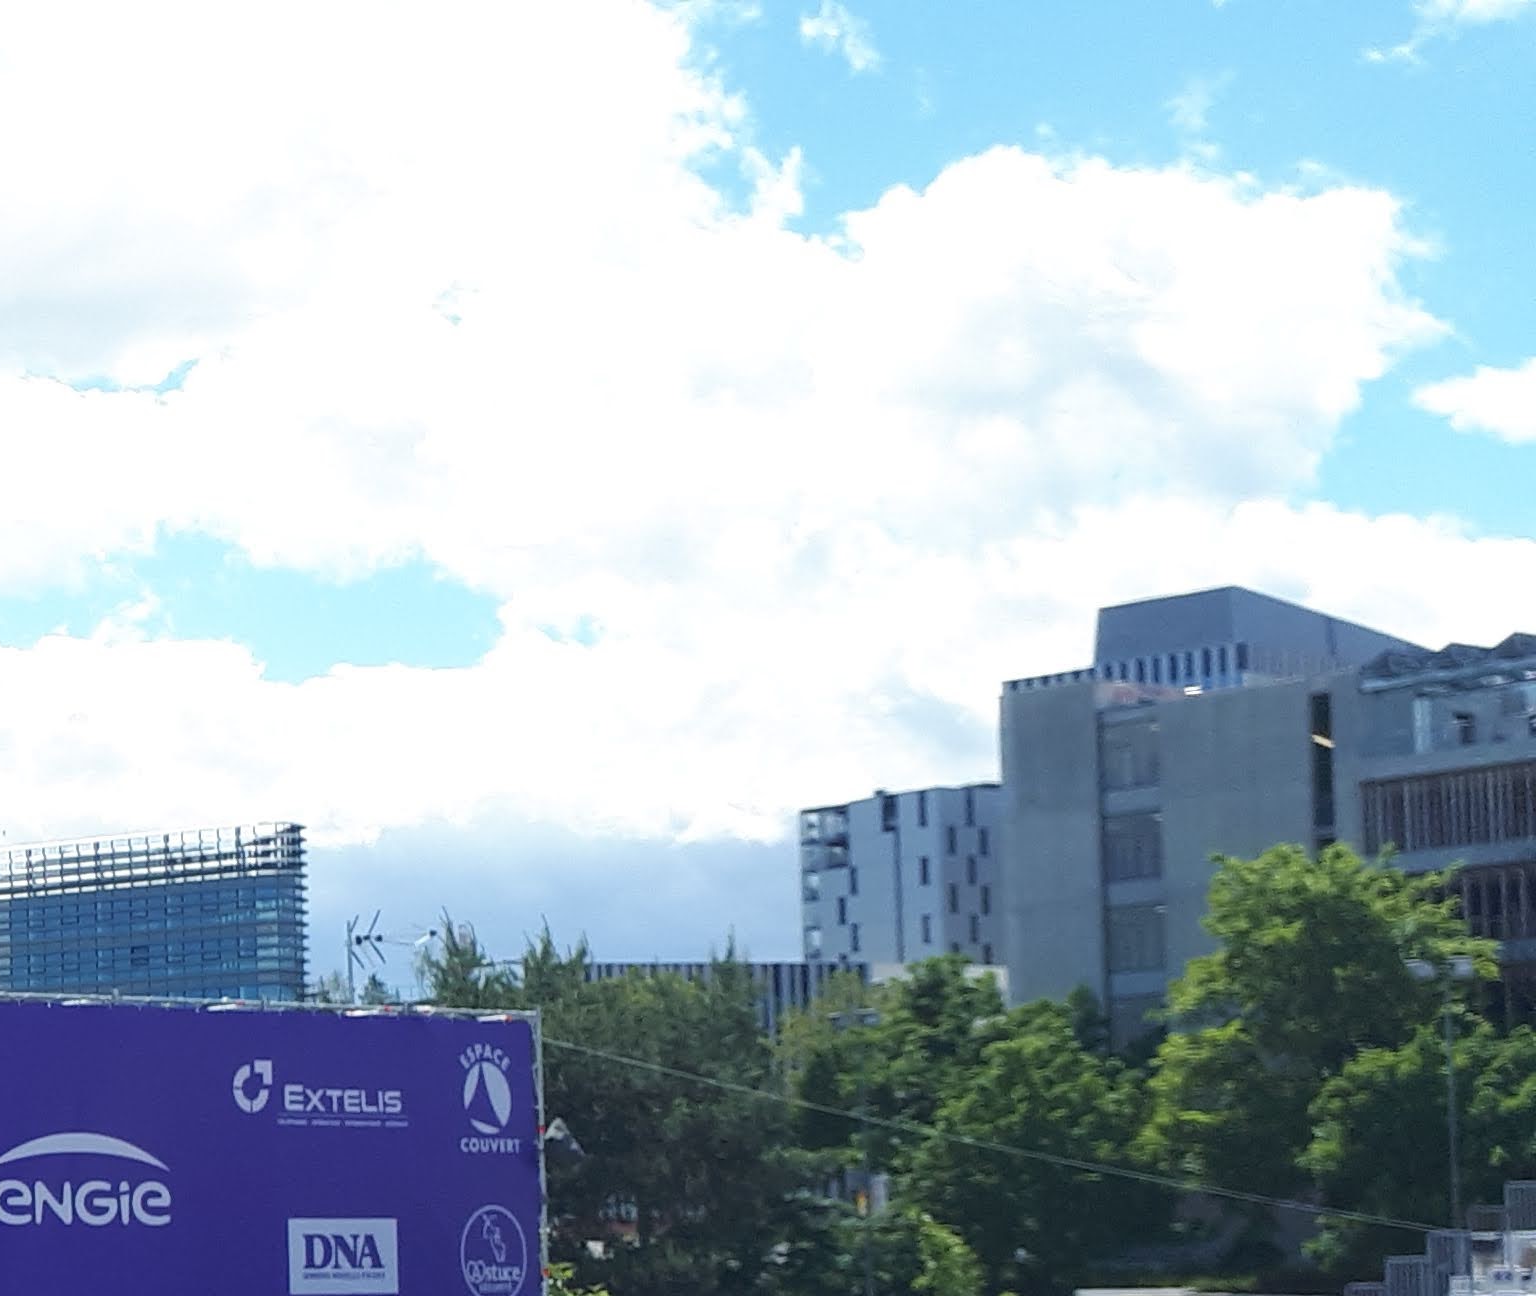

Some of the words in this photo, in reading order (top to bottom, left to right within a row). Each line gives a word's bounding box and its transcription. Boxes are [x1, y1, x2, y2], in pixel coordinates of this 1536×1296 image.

[459, 1042, 511, 1072] ESPACE
[460, 1136, 520, 1154] COUVERT
[302, 1233, 385, 1270] DNA
